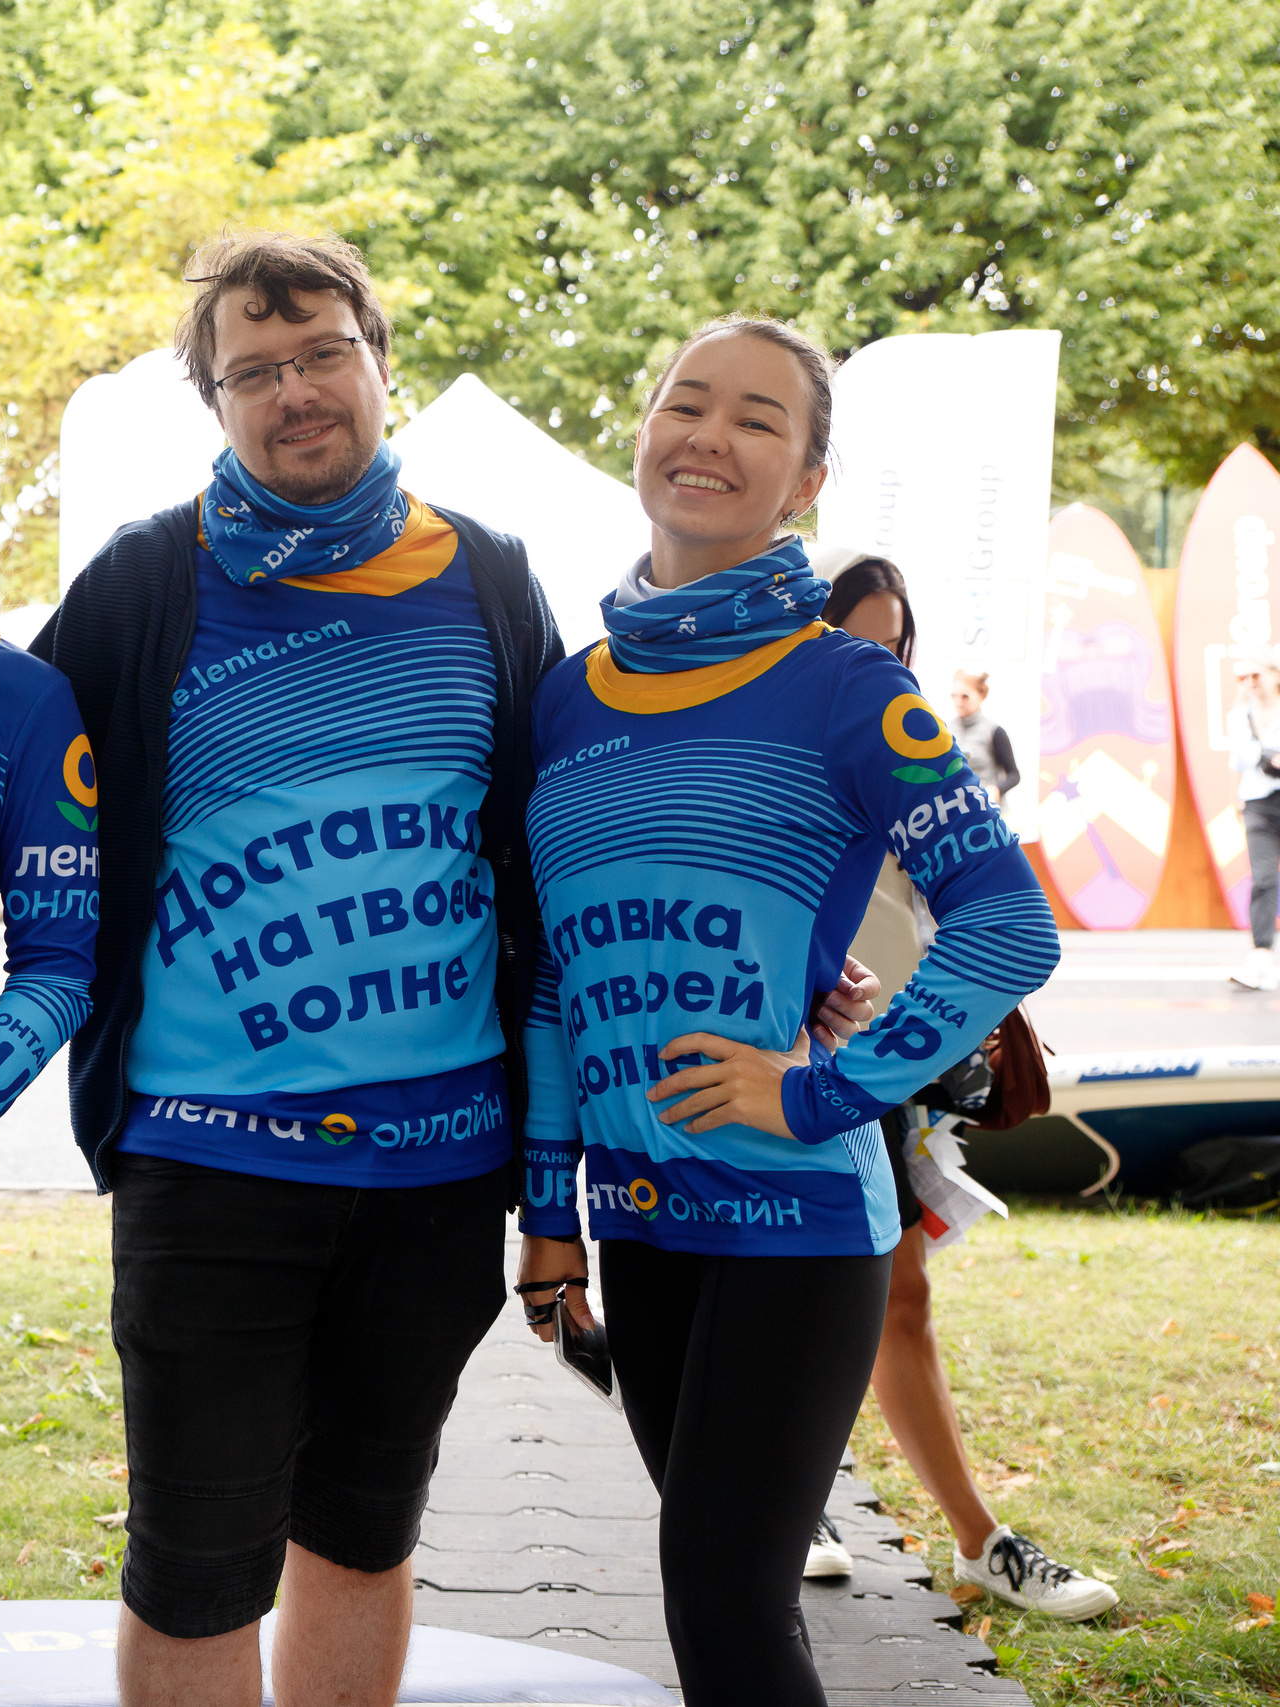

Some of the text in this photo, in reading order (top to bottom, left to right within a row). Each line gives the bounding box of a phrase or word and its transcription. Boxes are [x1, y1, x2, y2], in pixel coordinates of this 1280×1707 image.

[15, 845, 101, 878] лен
[211, 866, 494, 995] на твоей
[238, 955, 470, 1052] волне
[586, 959, 765, 1022] твоей
[370, 1091, 504, 1149] онлайн
[668, 1192, 803, 1226] онлайн
